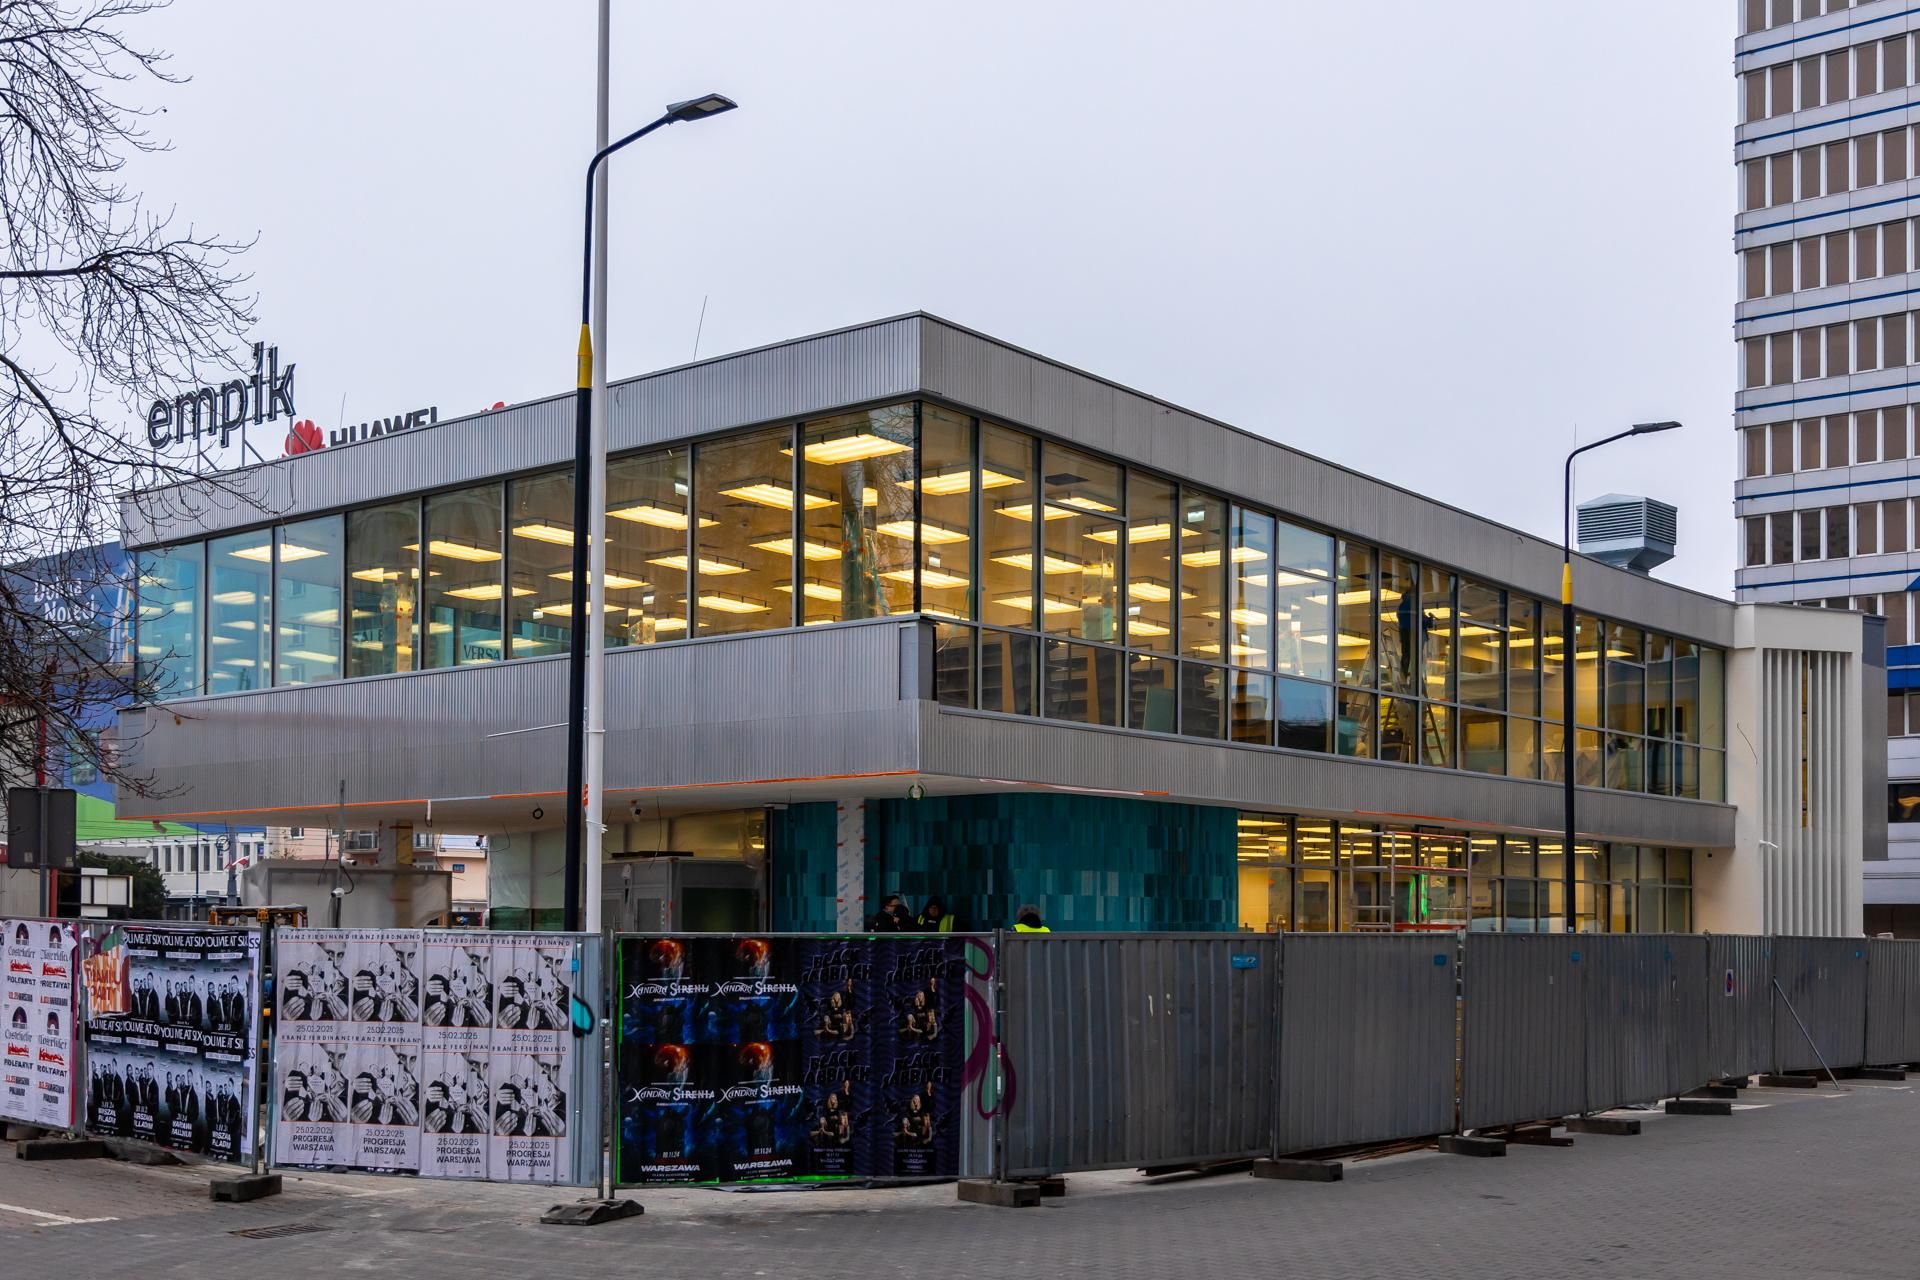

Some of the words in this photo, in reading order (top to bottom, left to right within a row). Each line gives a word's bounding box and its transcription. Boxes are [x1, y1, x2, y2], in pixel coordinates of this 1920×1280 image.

[147, 341, 296, 449] empik
[330, 406, 438, 447] HUAWEI
[293, 1135, 335, 1143] PROGRESJA
[363, 1138, 406, 1147] PROGRESJA
[293, 1144, 335, 1153] WARSZAWA
[363, 1147, 406, 1156] WARSZAWA
[506, 1150, 551, 1158] PROGRESJA
[640, 1164, 701, 1172] WARSZAWA
[733, 1159, 793, 1171] WARSZAWA
